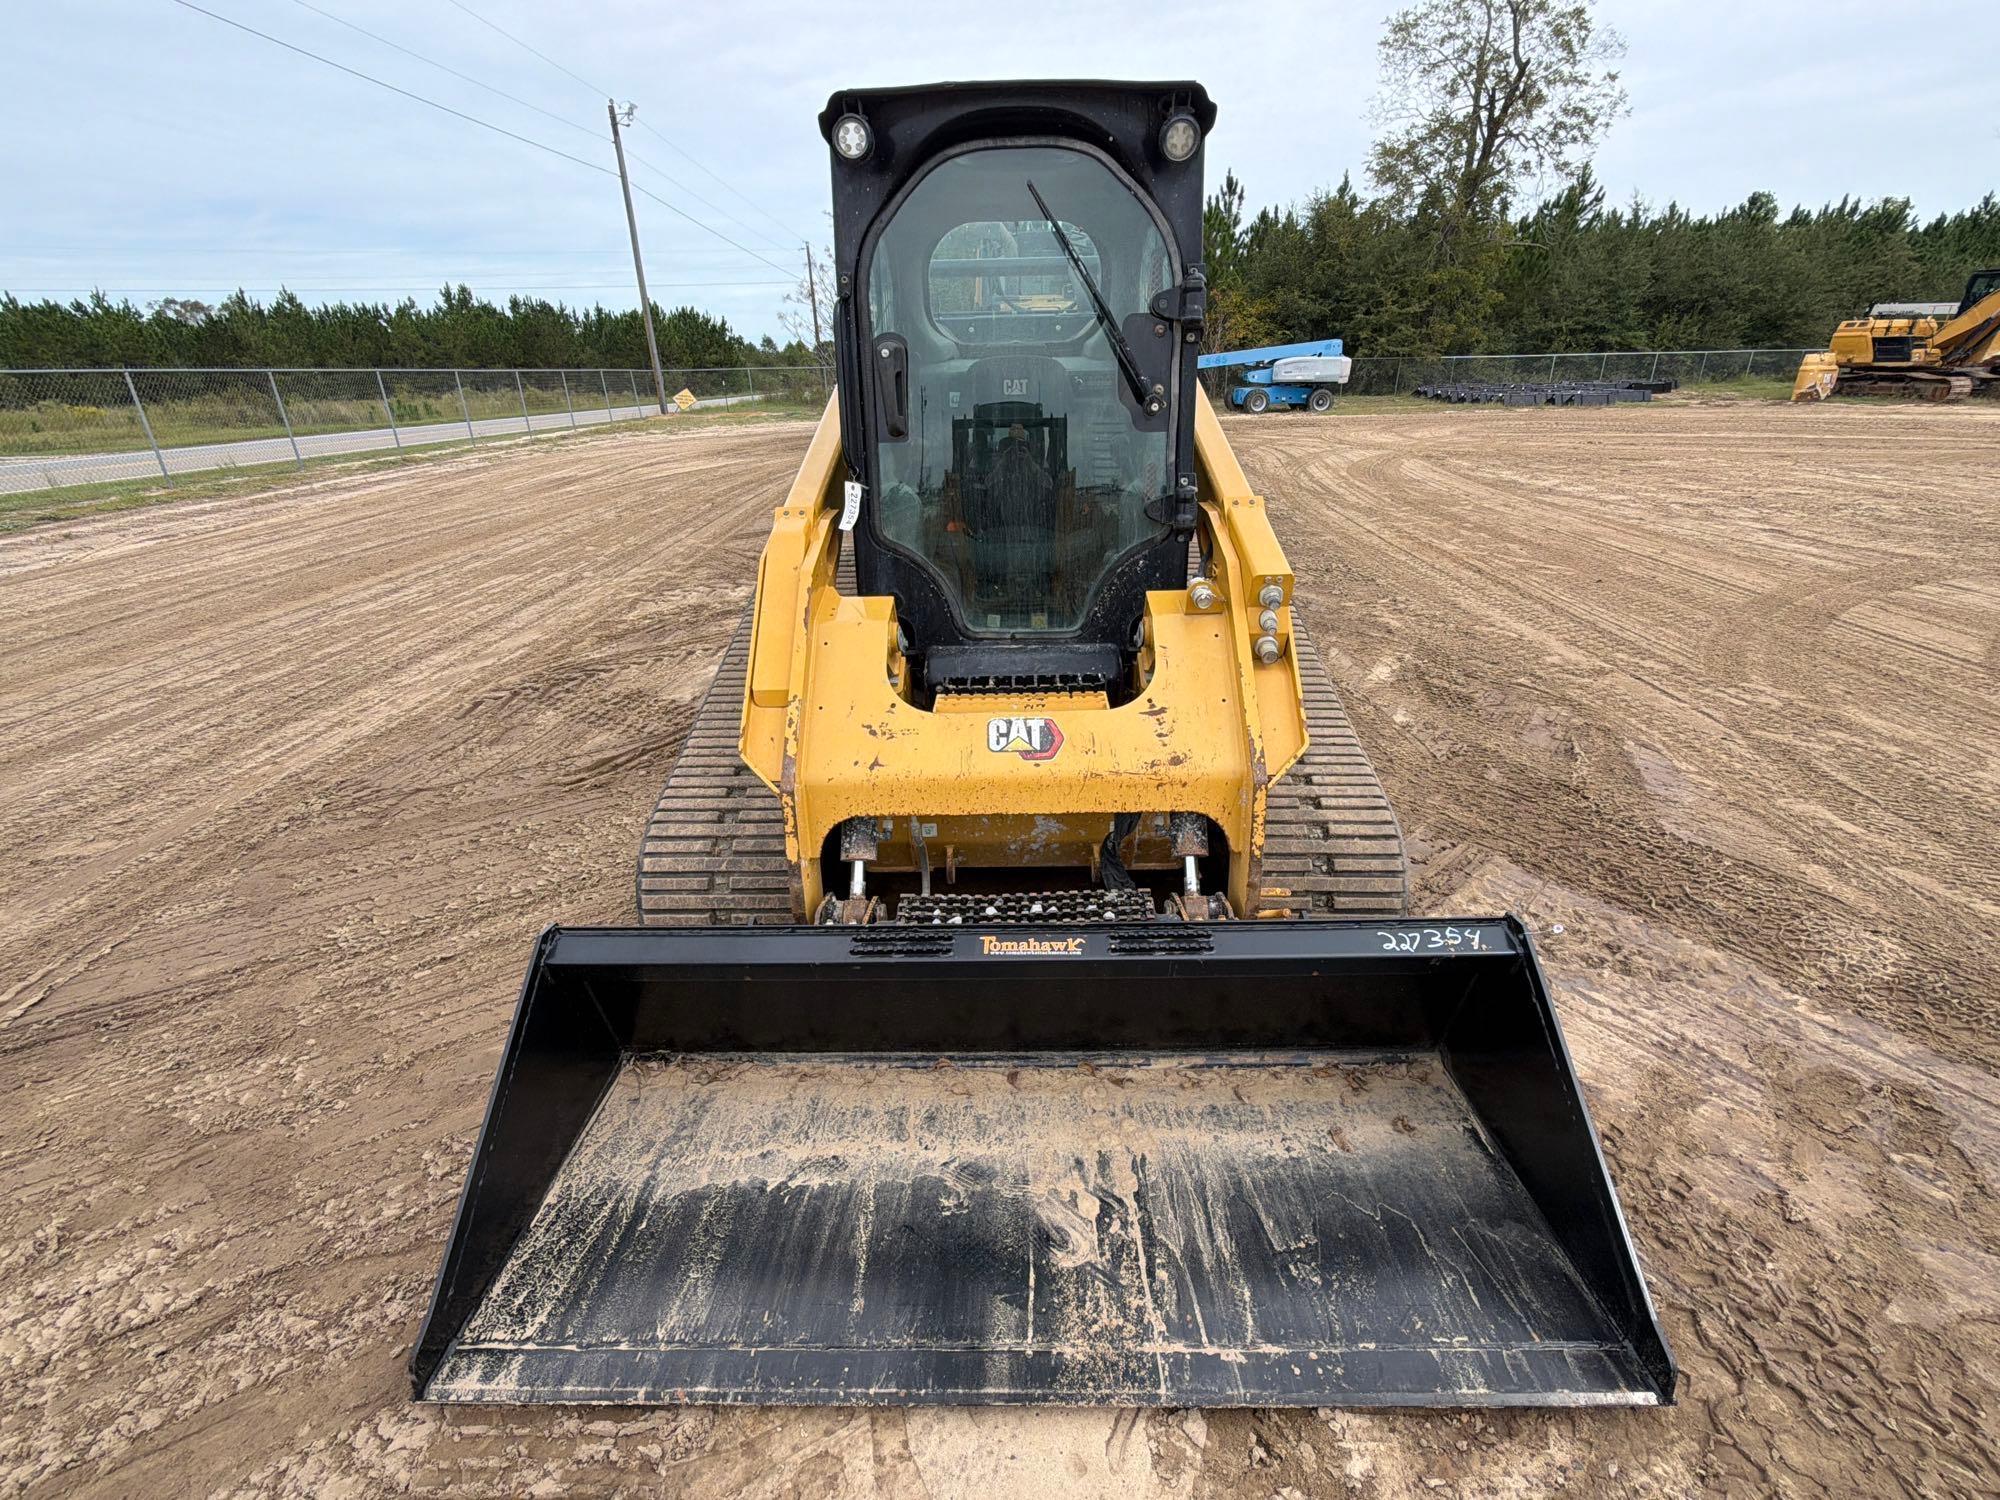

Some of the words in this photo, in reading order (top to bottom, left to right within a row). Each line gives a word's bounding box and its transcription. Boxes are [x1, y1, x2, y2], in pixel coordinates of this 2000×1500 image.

[1003, 379, 1028, 395] CAT
[846, 493, 858, 525] 227354
[988, 719, 1045, 751] CAT
[1376, 927, 1481, 953] 227354
